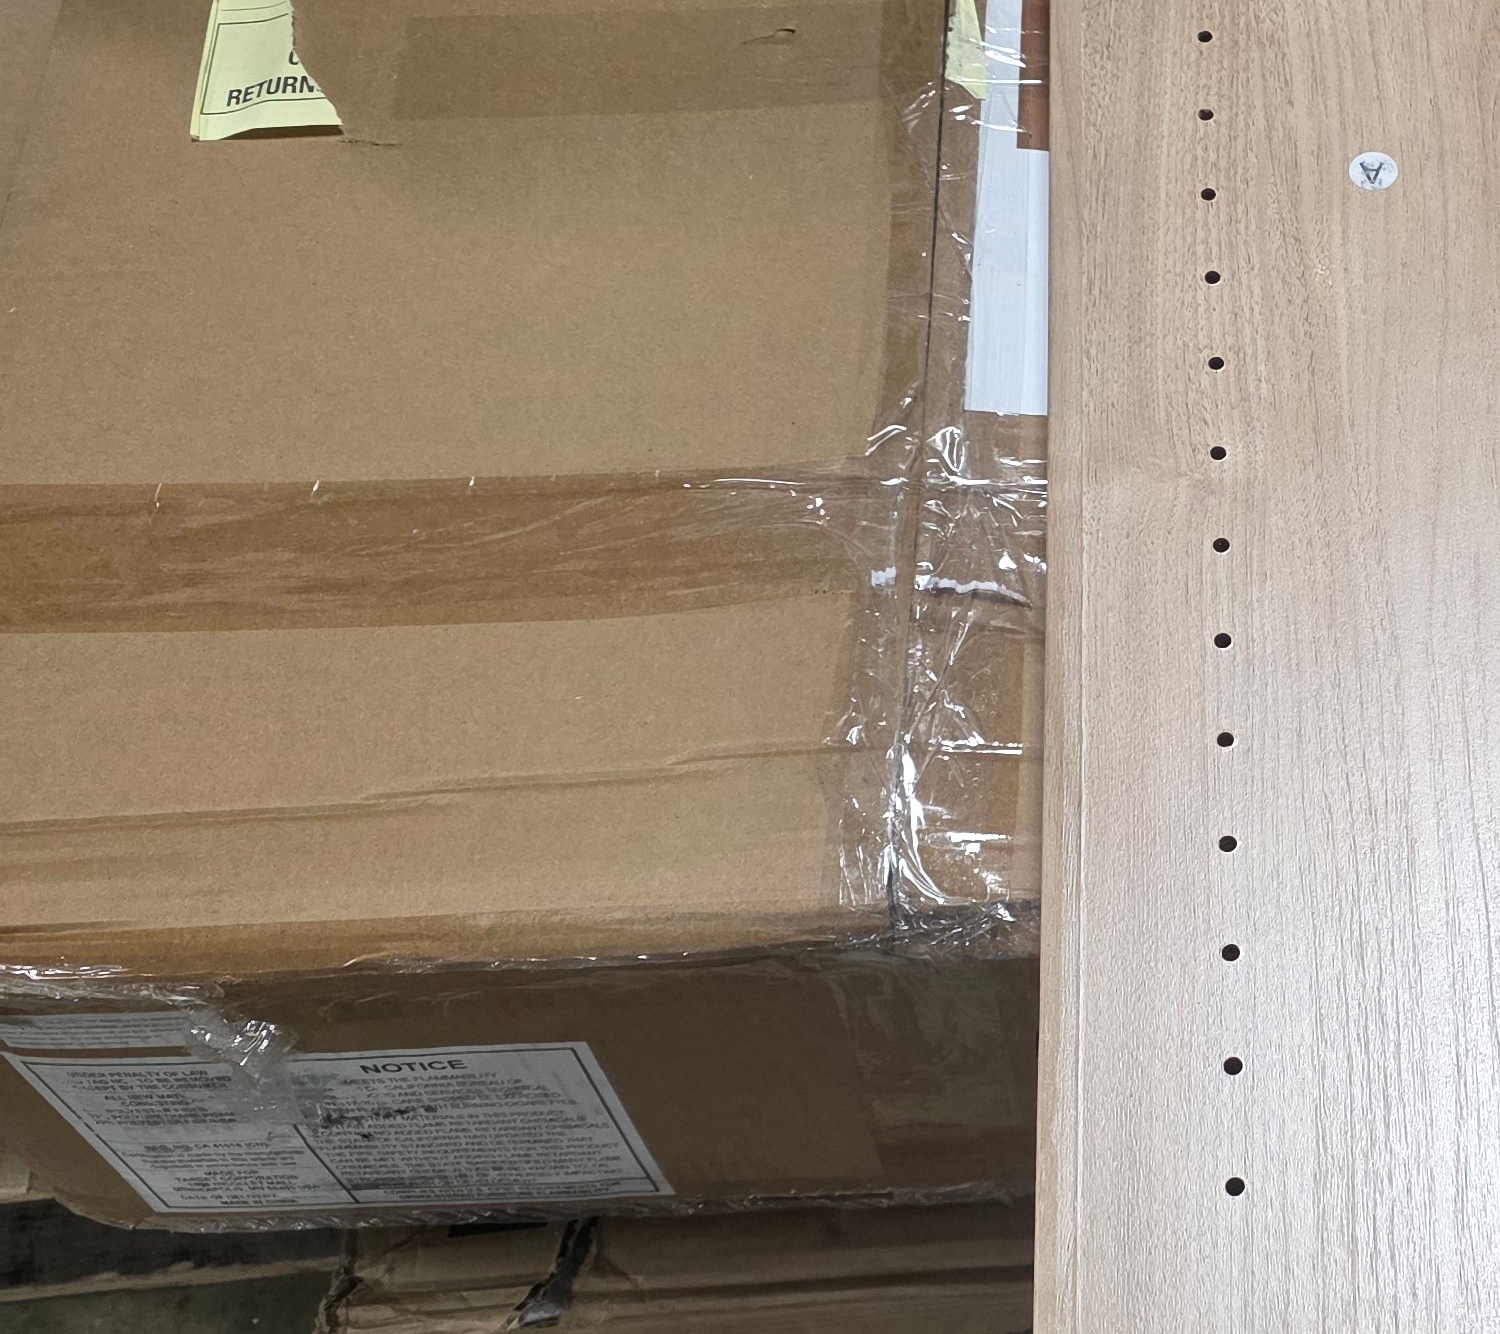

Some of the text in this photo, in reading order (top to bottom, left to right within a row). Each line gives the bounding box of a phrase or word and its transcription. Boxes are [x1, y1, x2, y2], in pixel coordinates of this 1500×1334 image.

[226, 75, 321, 107] RETURN
[1359, 161, 1384, 185] A
[359, 1059, 469, 1073] NOTICE
